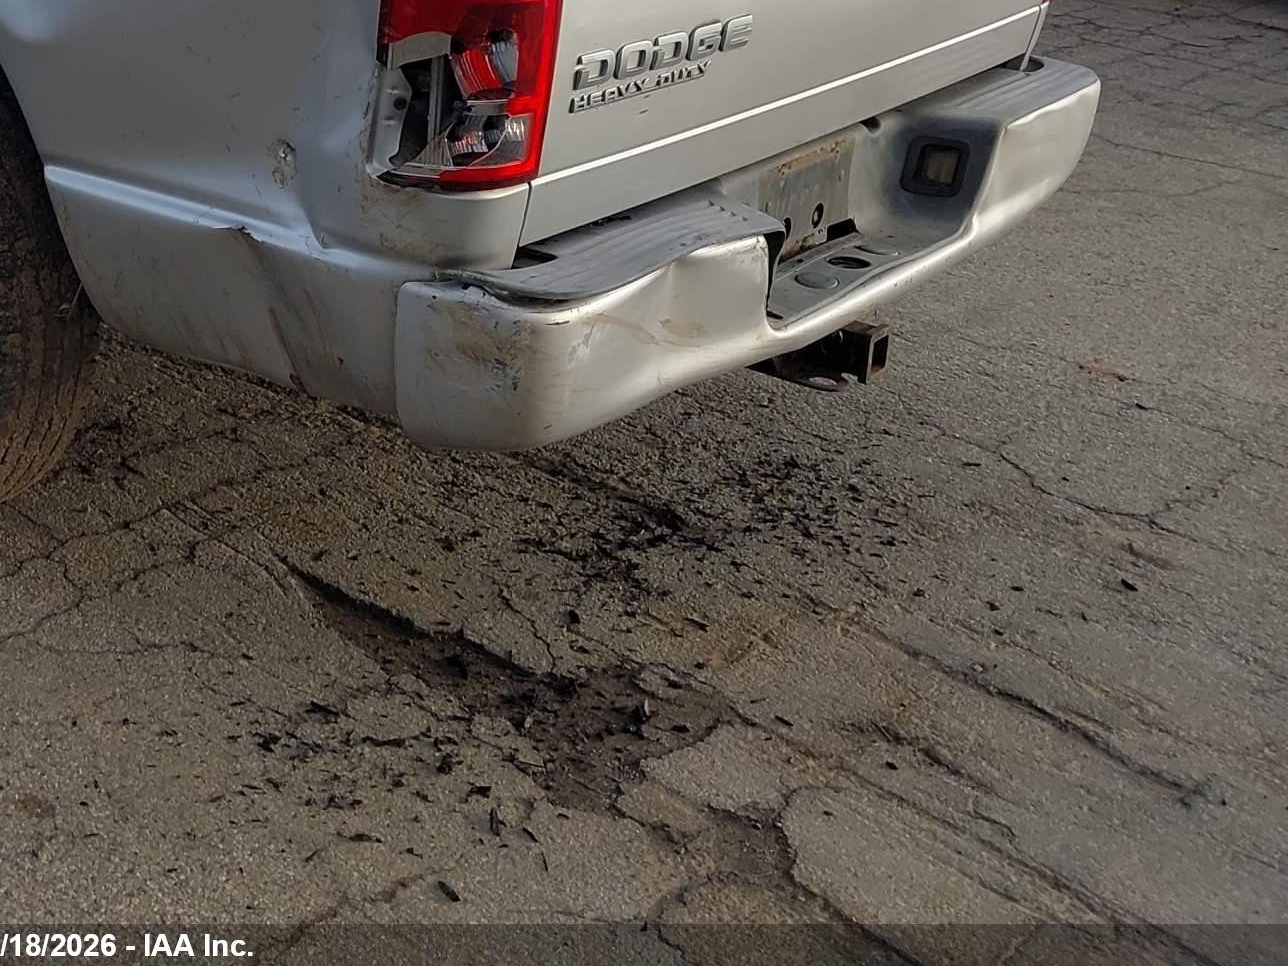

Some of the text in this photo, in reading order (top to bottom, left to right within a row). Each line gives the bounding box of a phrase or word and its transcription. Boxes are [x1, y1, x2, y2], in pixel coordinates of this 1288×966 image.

[572, 13, 753, 91] DODGE
[568, 59, 712, 114] HEAVY DUTY
